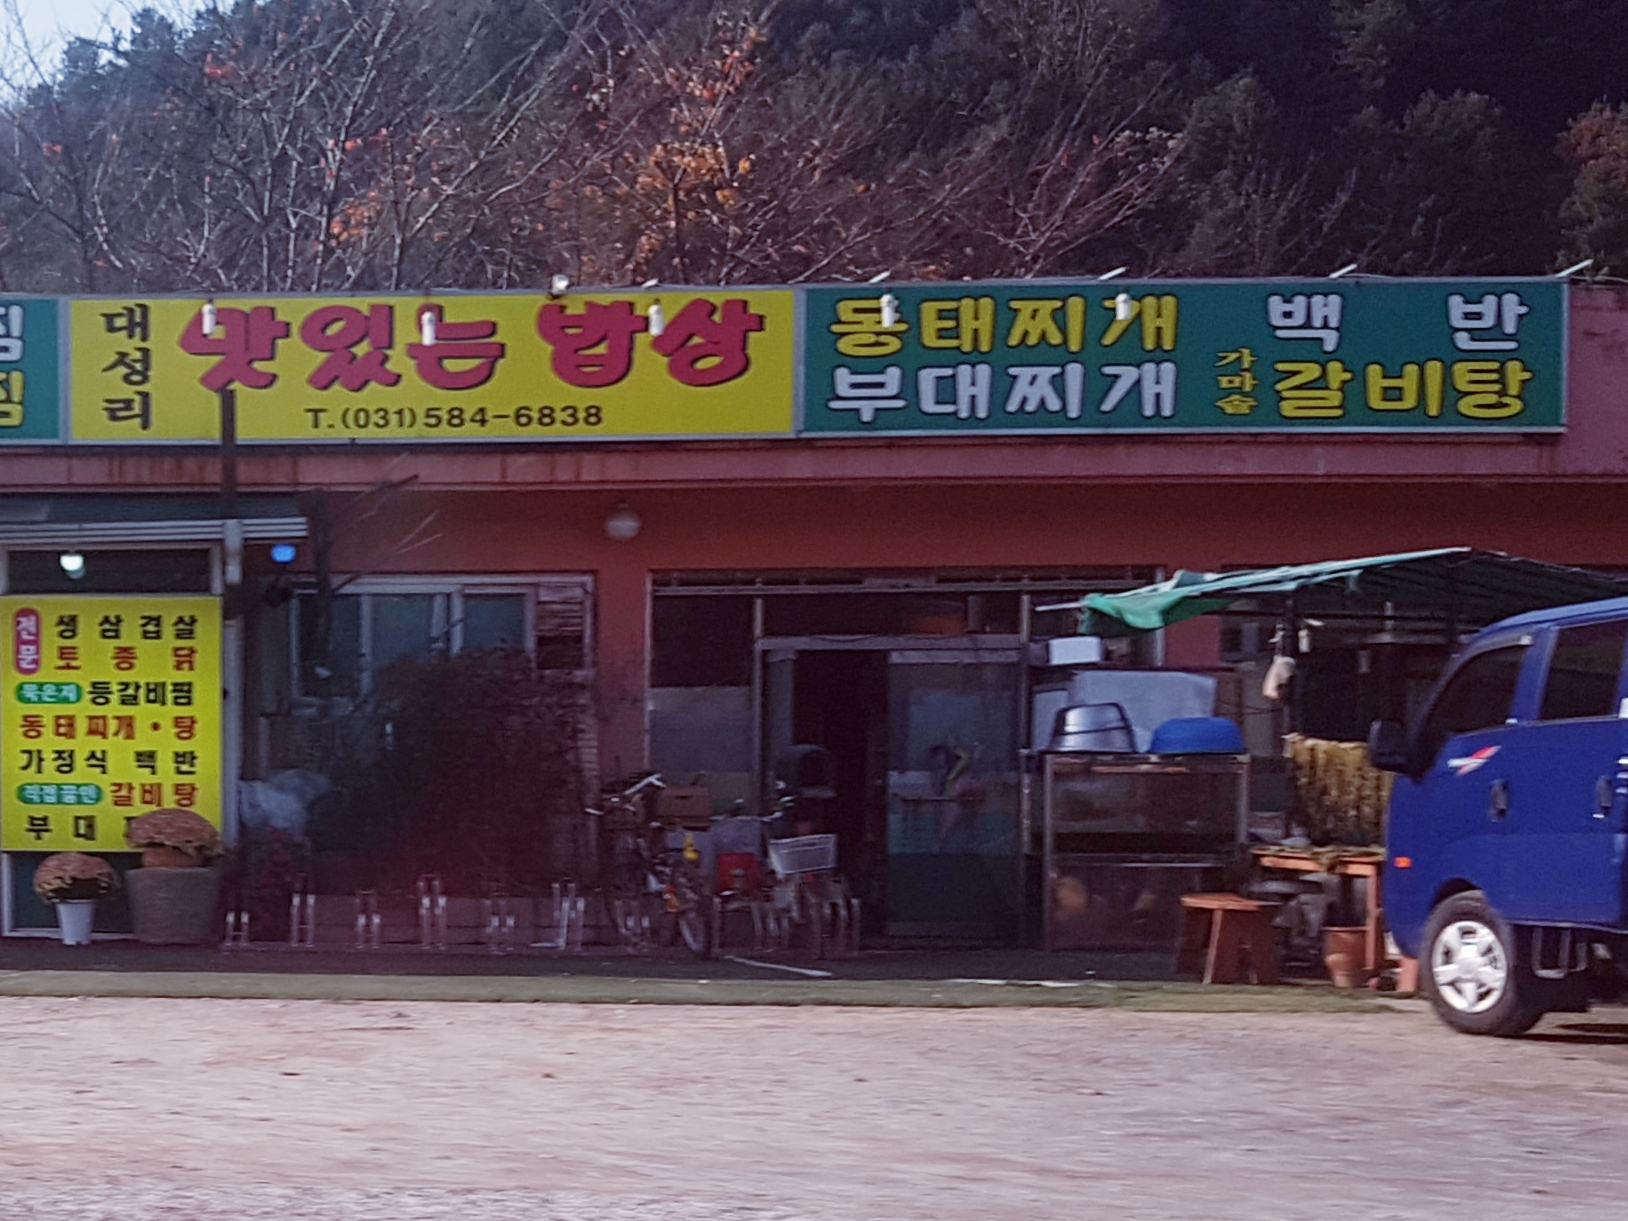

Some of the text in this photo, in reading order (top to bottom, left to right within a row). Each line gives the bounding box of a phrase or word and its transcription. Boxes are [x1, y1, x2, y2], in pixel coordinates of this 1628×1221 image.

[178, 297, 766, 393] 맛있는 밥상
[829, 295, 1178, 358] 동태찌개
[101, 302, 152, 431] 대성리
[827, 361, 1177, 424] 부대찌개
[1215, 347, 1259, 416] 가마솥
[1273, 359, 1534, 418] 갈비탕
[304, 405, 603, 430] T.(031)584-6838
[54, 645, 198, 671] 토종닭
[19, 749, 109, 775] 가정식
[109, 782, 198, 807] 갈비탕
